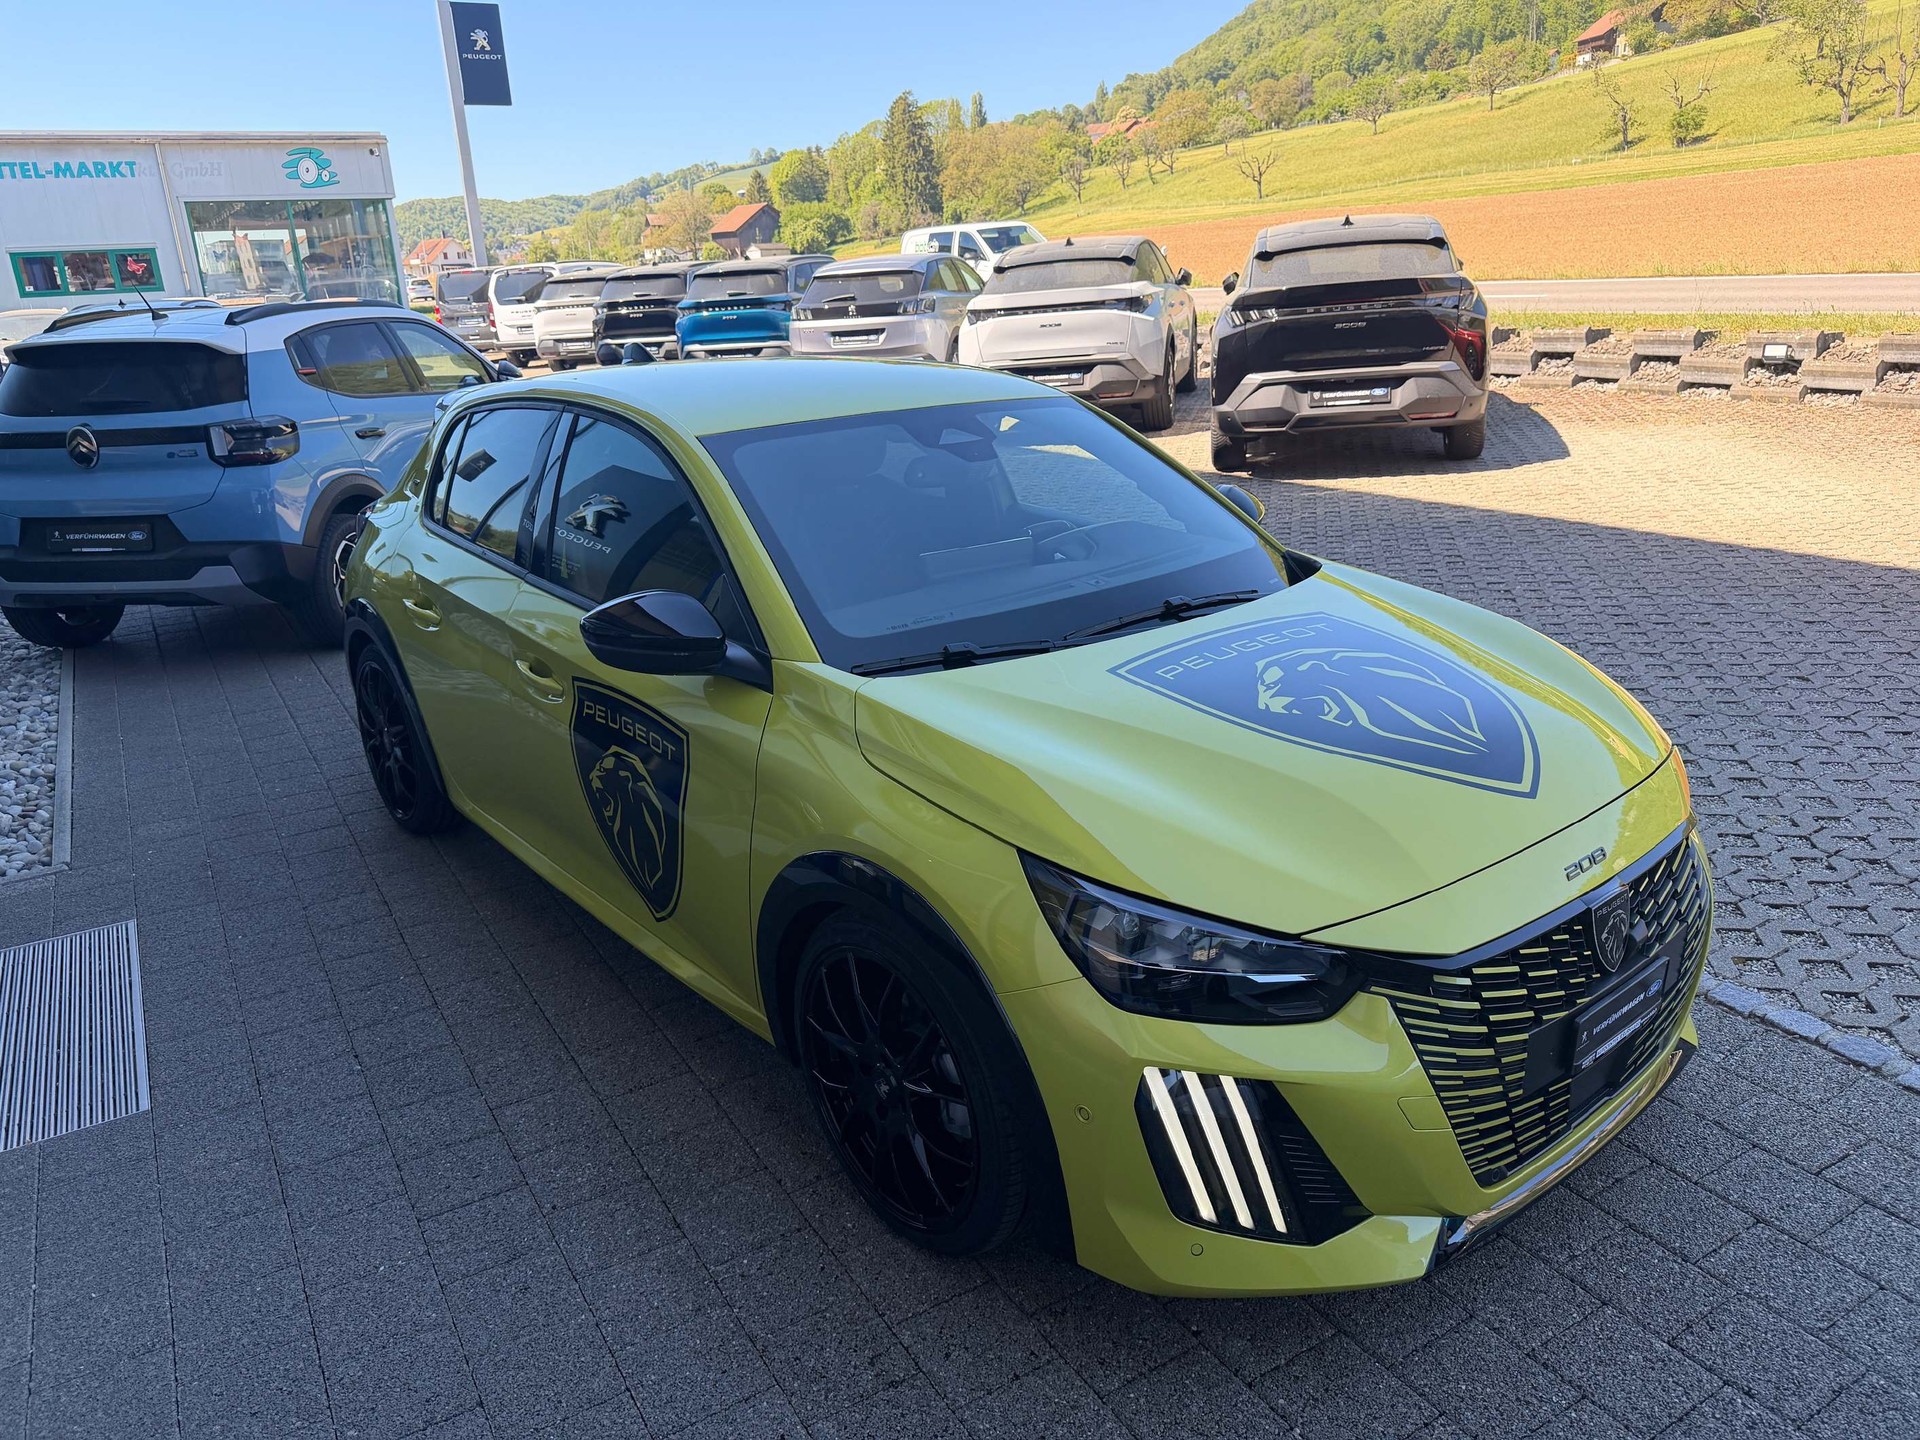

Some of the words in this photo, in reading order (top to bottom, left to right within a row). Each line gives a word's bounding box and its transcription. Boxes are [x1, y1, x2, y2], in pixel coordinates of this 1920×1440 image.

[1155, 623, 1333, 680] PEUGEOT
[583, 701, 676, 760] PEUGEOT
[1564, 846, 1607, 881] 208
[1596, 893, 1628, 918] PEUGEOT
